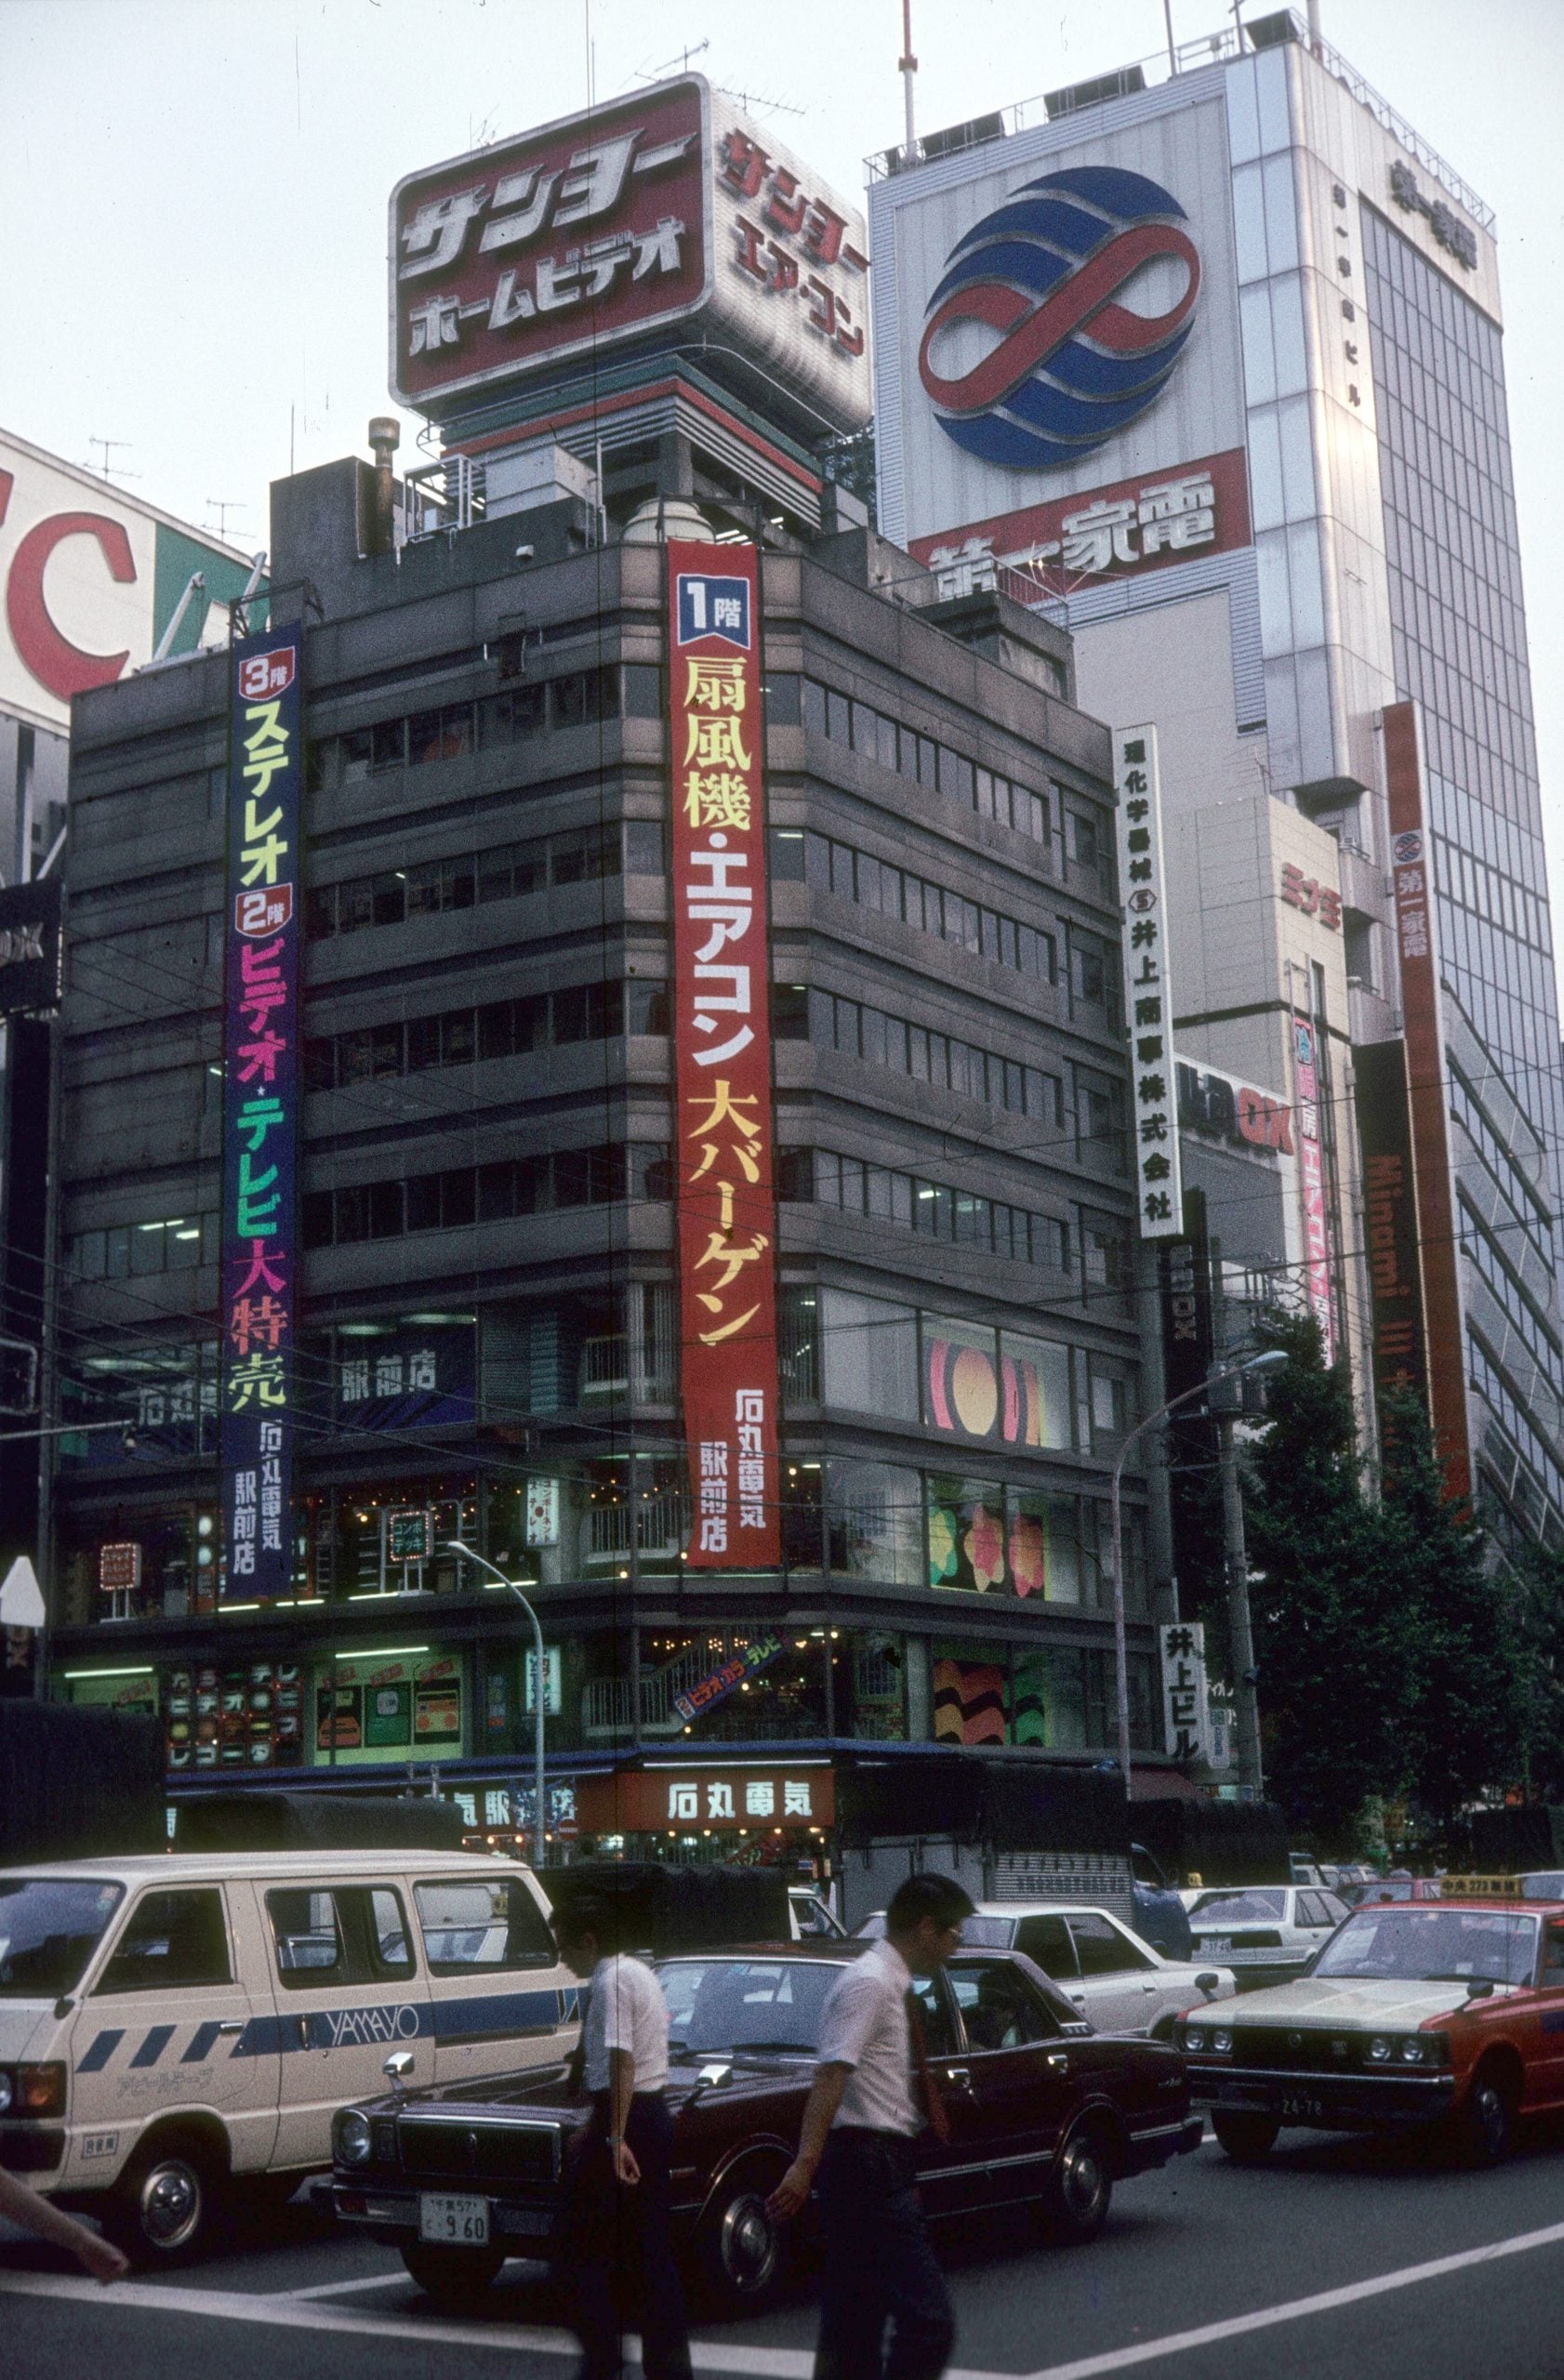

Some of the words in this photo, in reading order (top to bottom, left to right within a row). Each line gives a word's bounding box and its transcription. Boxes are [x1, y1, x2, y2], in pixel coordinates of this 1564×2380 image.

[397, 127, 697, 281] サンヨー
[722, 127, 872, 272] サンヨー
[408, 215, 685, 357] ホームビデオ
[0, 469, 138, 706] C
[929, 471, 1216, 602] 第一家電
[686, 581, 742, 629] 1階
[245, 657, 287, 696] 3階
[240, 700, 290, 887] ステレオ
[242, 892, 285, 931] 2階
[1281, 862, 1343, 932] ミナミ
[1366, 1155, 1411, 1299] Minami
[228, 1238, 288, 1412] 大特売
[341, 1349, 436, 1402] 駅前店
[232, 1471, 258, 1575] 駅前店
[258, 1420, 283, 1551] 石丸電気
[700, 1441, 728, 1553] 駅前店
[736, 1388, 766, 1528] 石丸電気
[1166, 1627, 1200, 1759] 井上ビル
[668, 1780, 814, 1820] 石丸電気
